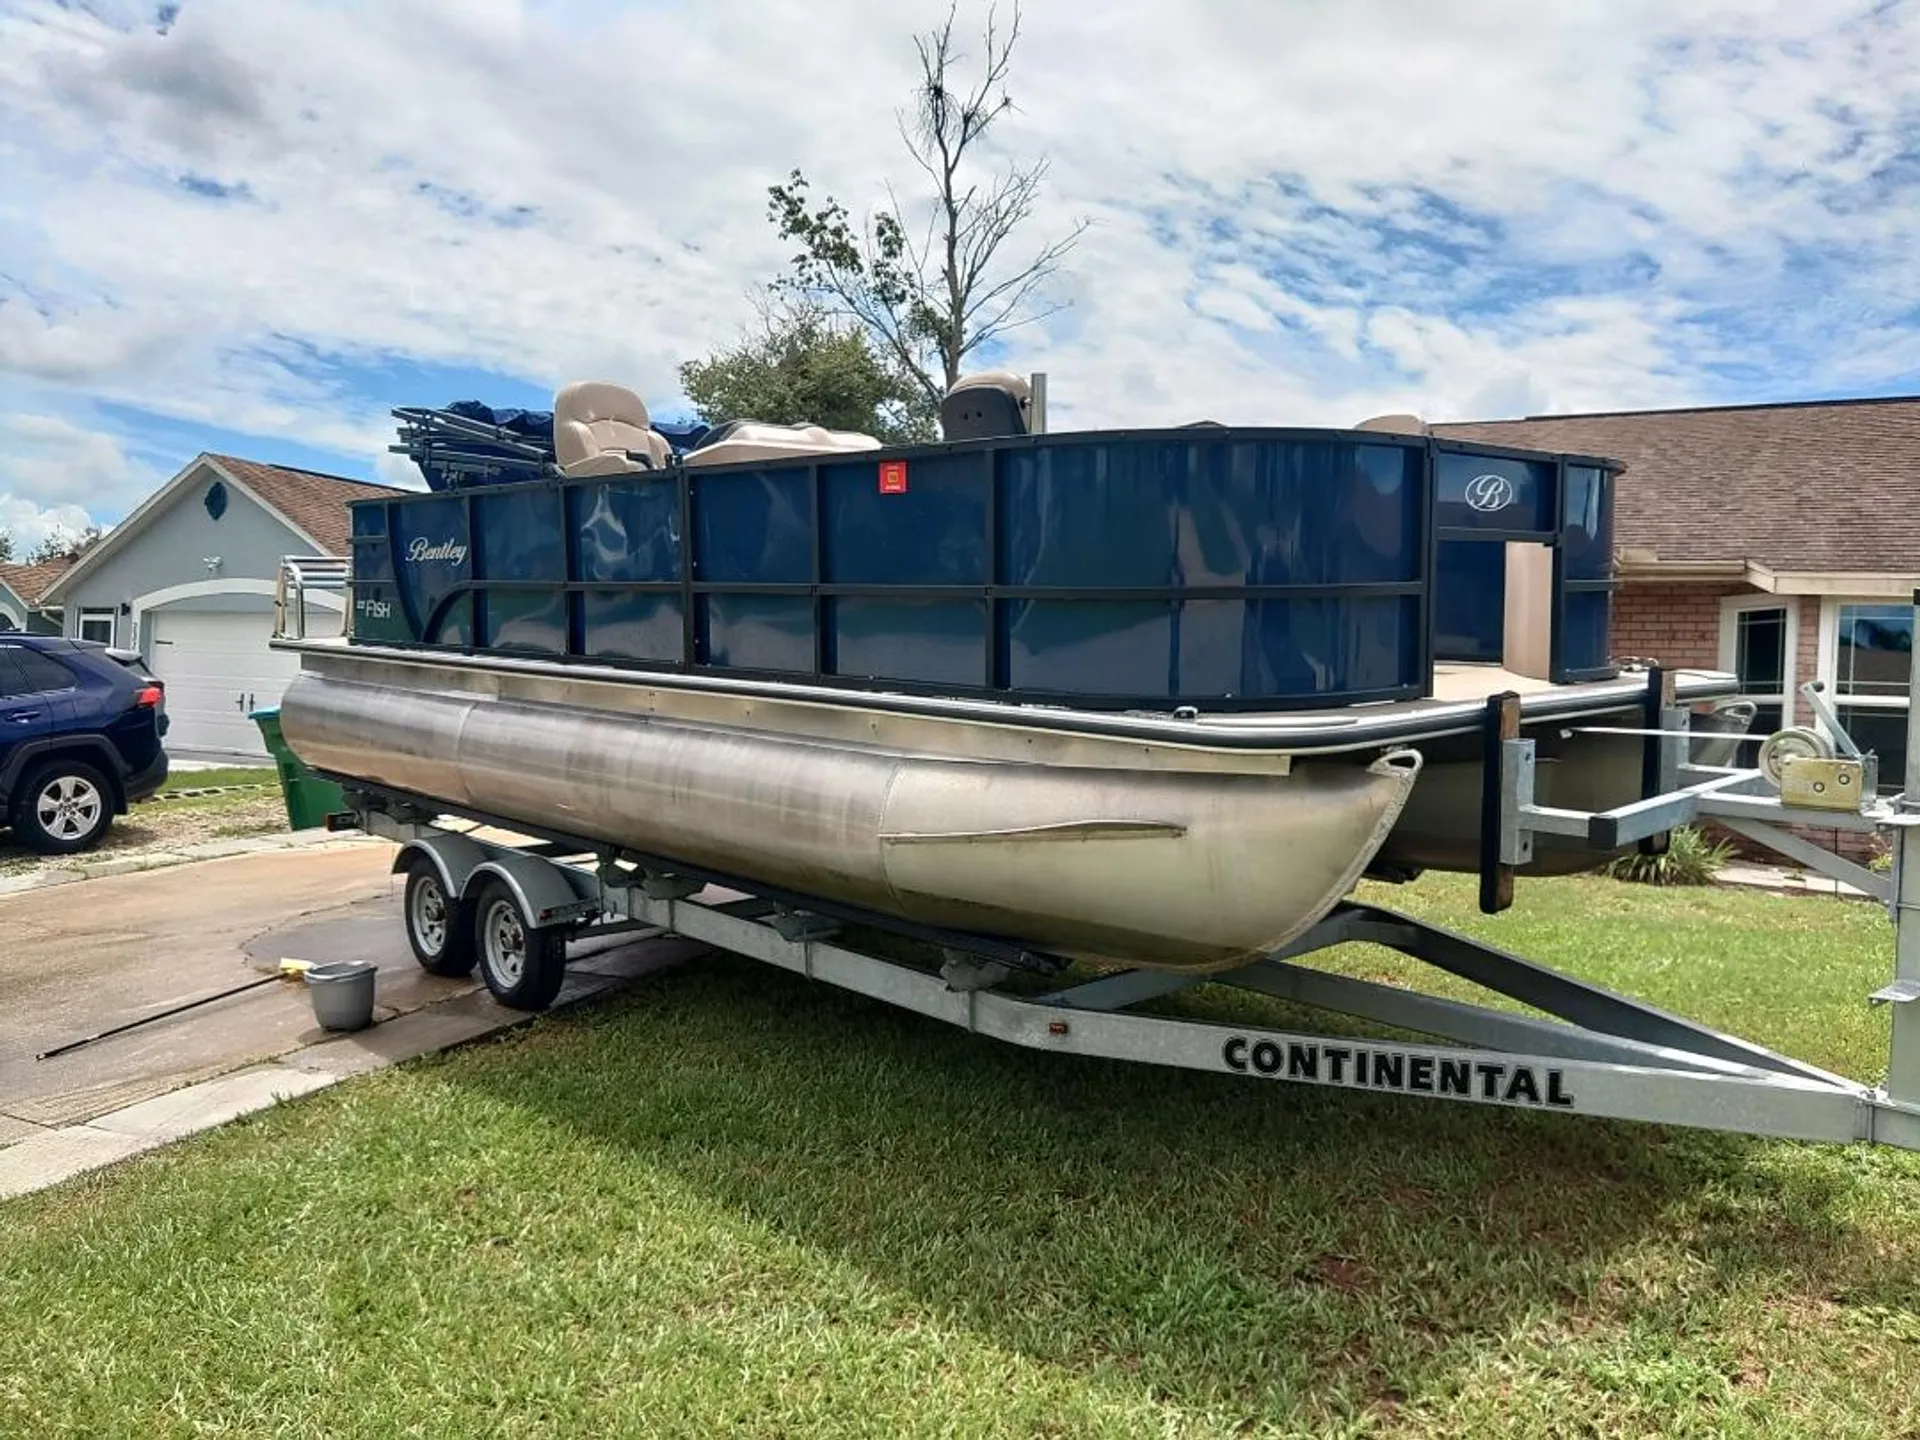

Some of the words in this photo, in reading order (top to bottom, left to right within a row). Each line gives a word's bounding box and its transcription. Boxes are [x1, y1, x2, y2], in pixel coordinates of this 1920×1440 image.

[1474, 475, 1504, 508] B
[405, 536, 467, 566] Bentley
[366, 600, 391, 618] FISH
[1222, 1036, 1575, 1108] CONTINENTAL
